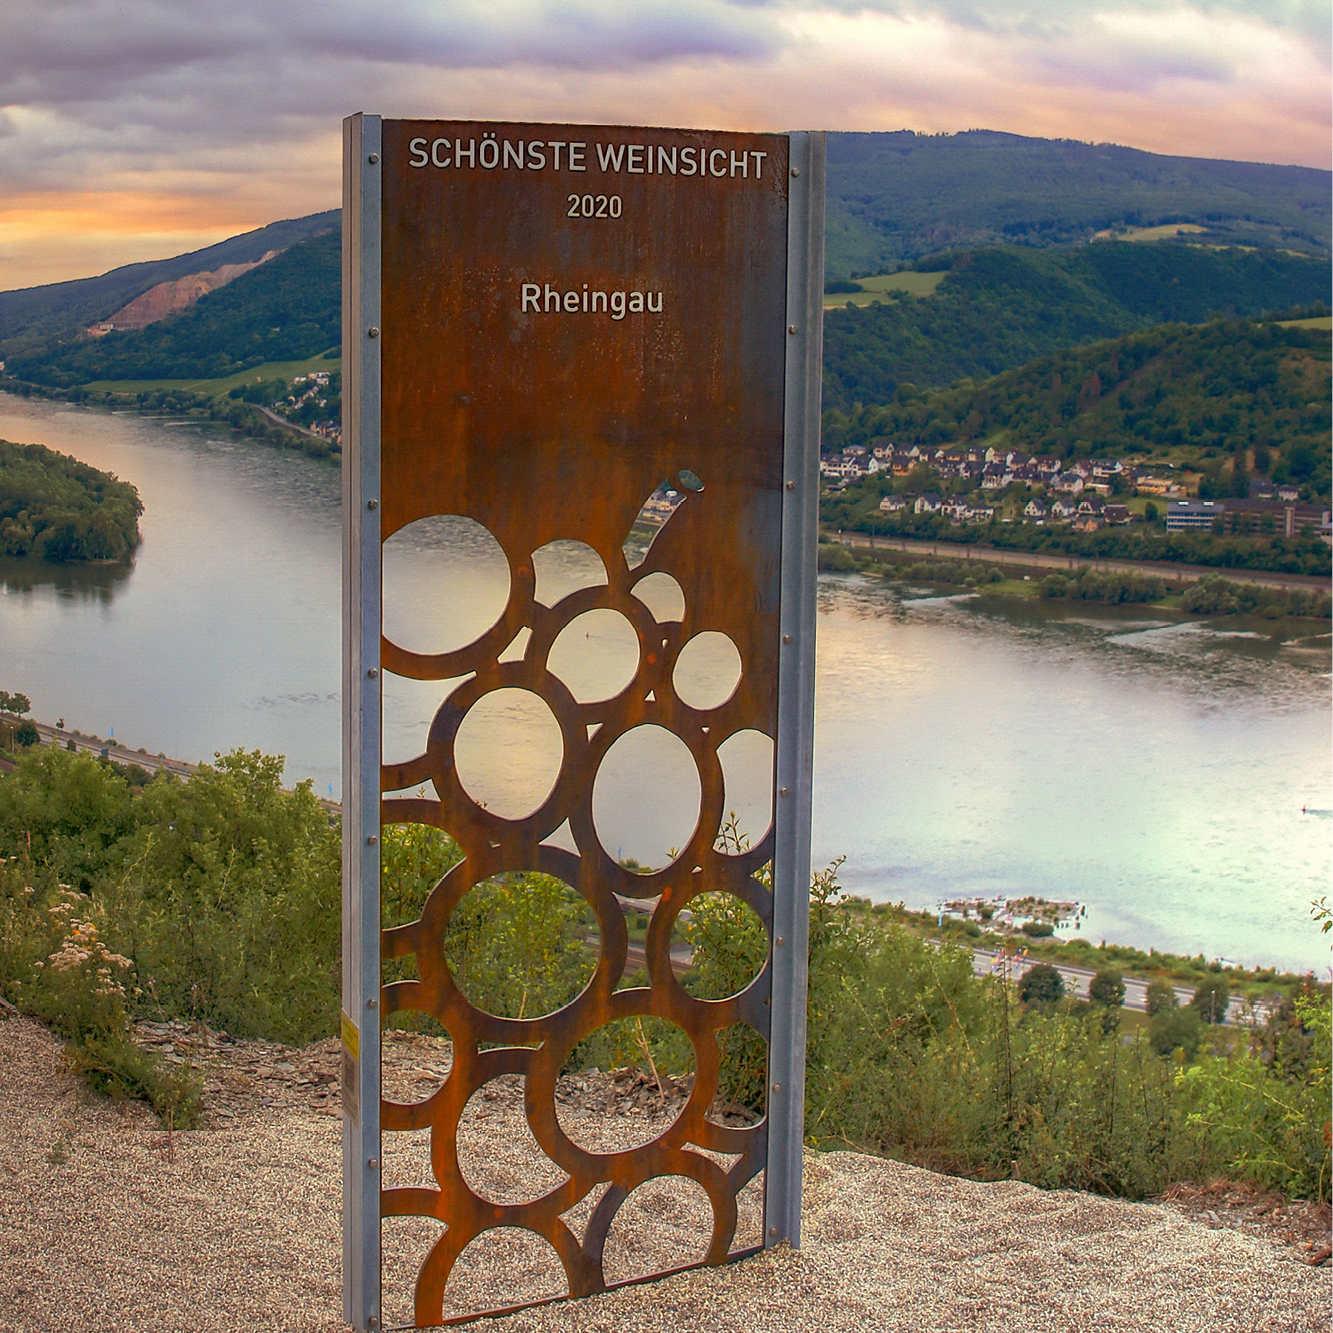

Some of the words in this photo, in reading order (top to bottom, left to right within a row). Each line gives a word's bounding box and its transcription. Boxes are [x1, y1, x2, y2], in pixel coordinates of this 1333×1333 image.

[408, 132, 587, 172] SCHÖNSTE
[595, 142, 768, 180] WEINSICHT
[566, 193, 623, 219] 2020
[521, 283, 664, 321] Rheingau
